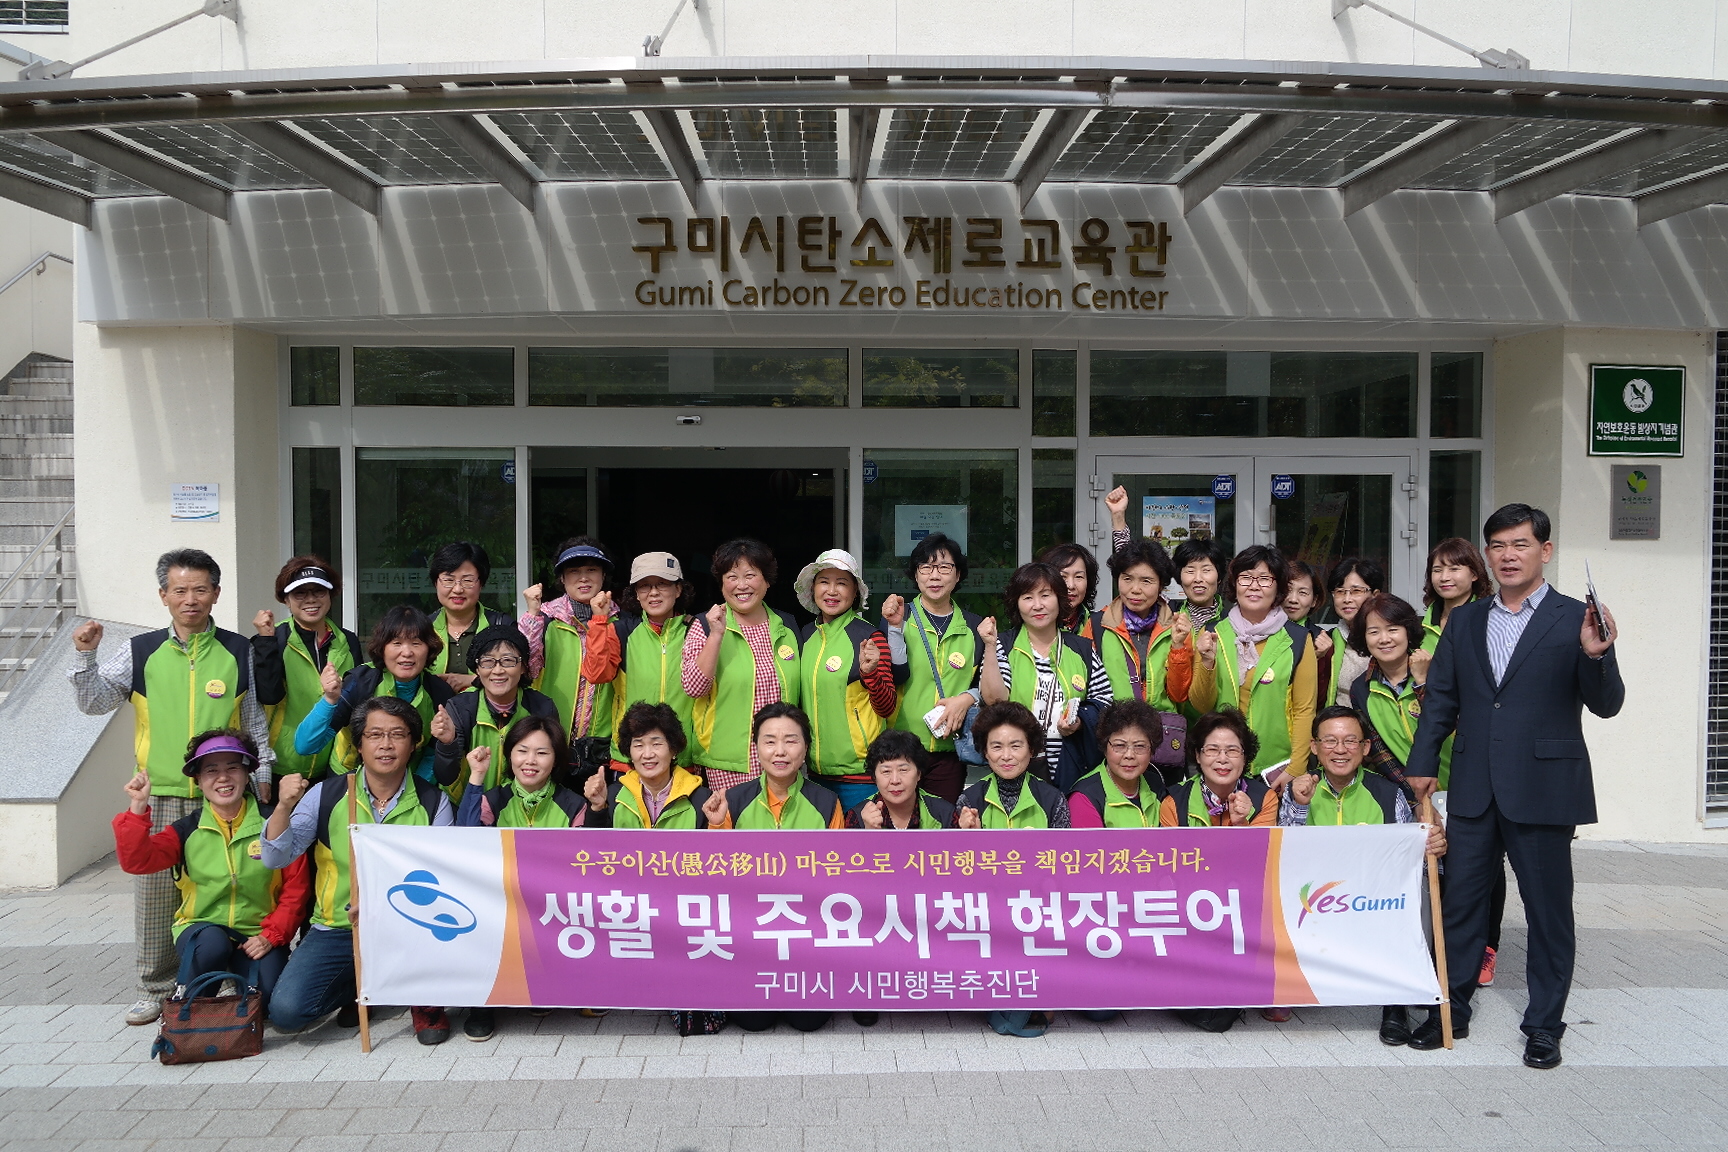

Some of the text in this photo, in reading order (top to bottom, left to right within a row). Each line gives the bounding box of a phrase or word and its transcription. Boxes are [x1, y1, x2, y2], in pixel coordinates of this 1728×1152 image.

[631, 216, 1173, 278] 구미시탄소제로교육관
[634, 279, 1170, 311] Gumi Carbon Zero Education Center
[1596, 421, 1636, 435] 자연보호운동
[1658, 423, 1679, 435] 기념관
[1216, 482, 1232, 491] ADT
[1275, 482, 1292, 491] ADT
[570, 847, 1210, 877] 우공이산(愚公移山) 마음으로 시민행복을 책임지겠습니다.
[1298, 880, 1406, 929] Yes Gumi
[539, 888, 1246, 961] 생활 및 주요시책 현장투어
[754, 968, 1040, 1000] 구미시 시민행복추진단
